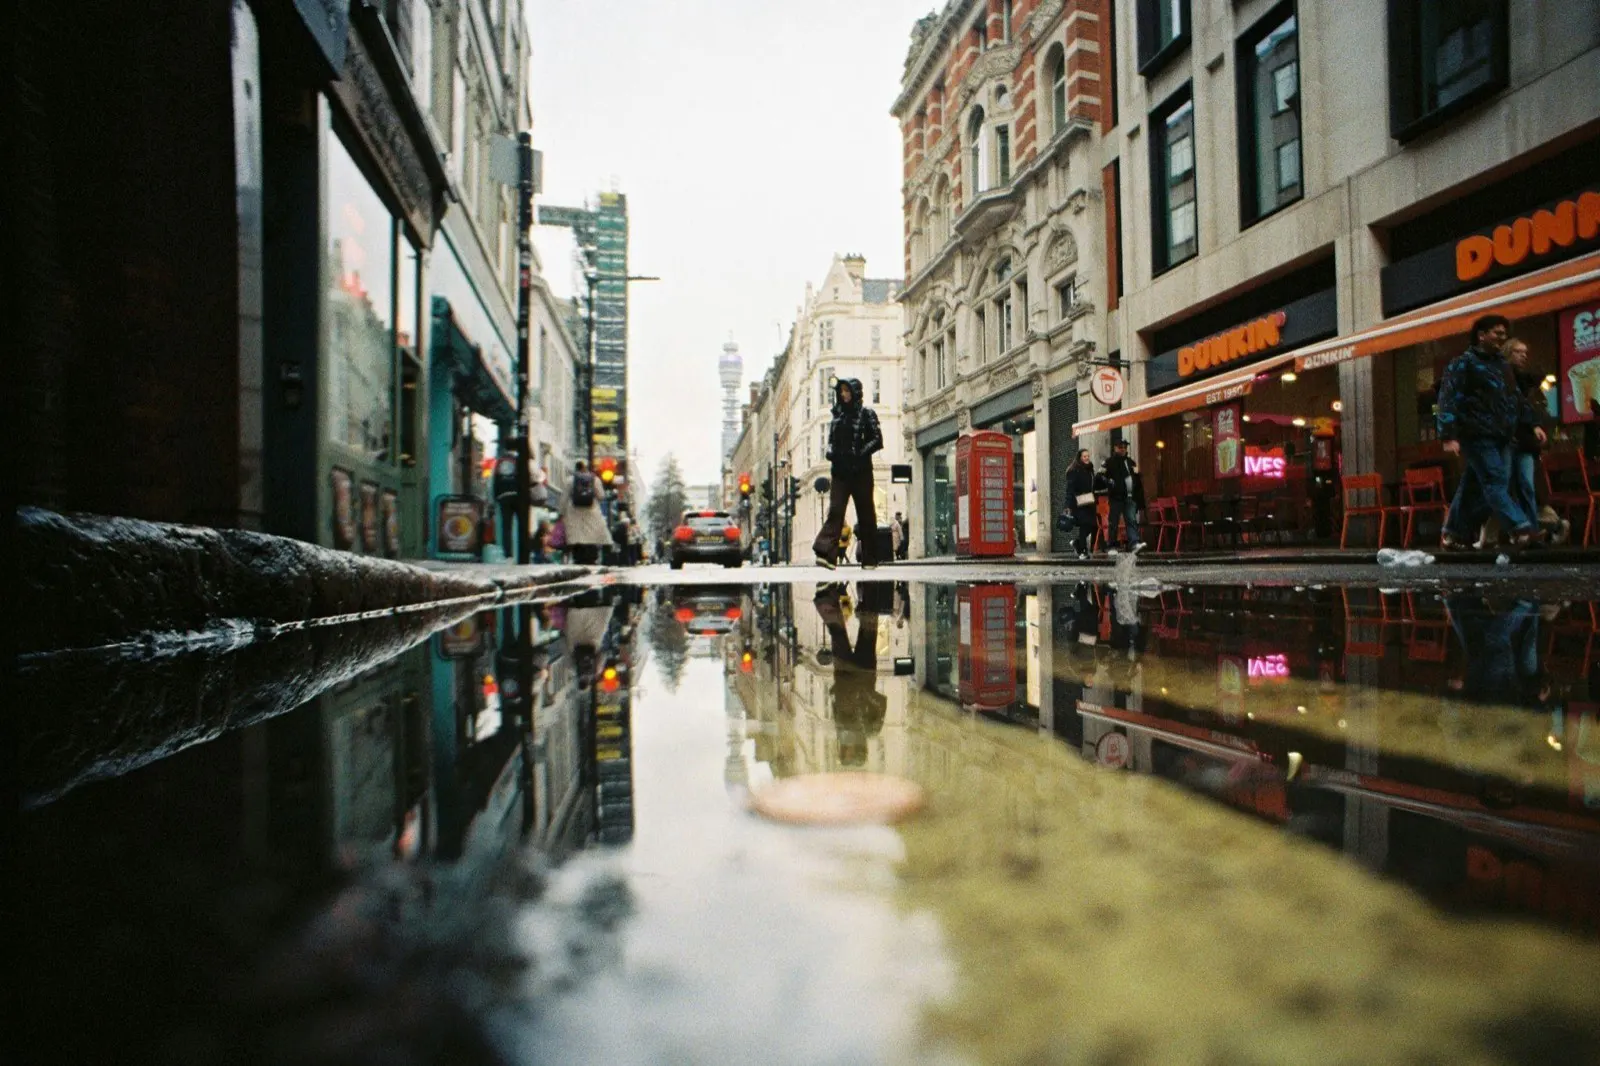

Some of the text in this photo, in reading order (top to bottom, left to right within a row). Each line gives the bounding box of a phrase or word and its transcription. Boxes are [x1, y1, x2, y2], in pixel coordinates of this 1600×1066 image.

[1177, 312, 1286, 377] DUNKIN'
[1303, 346, 1355, 370] DUNKIN'
[1104, 383, 1112, 393] D
[1206, 390, 1220, 404] EST
